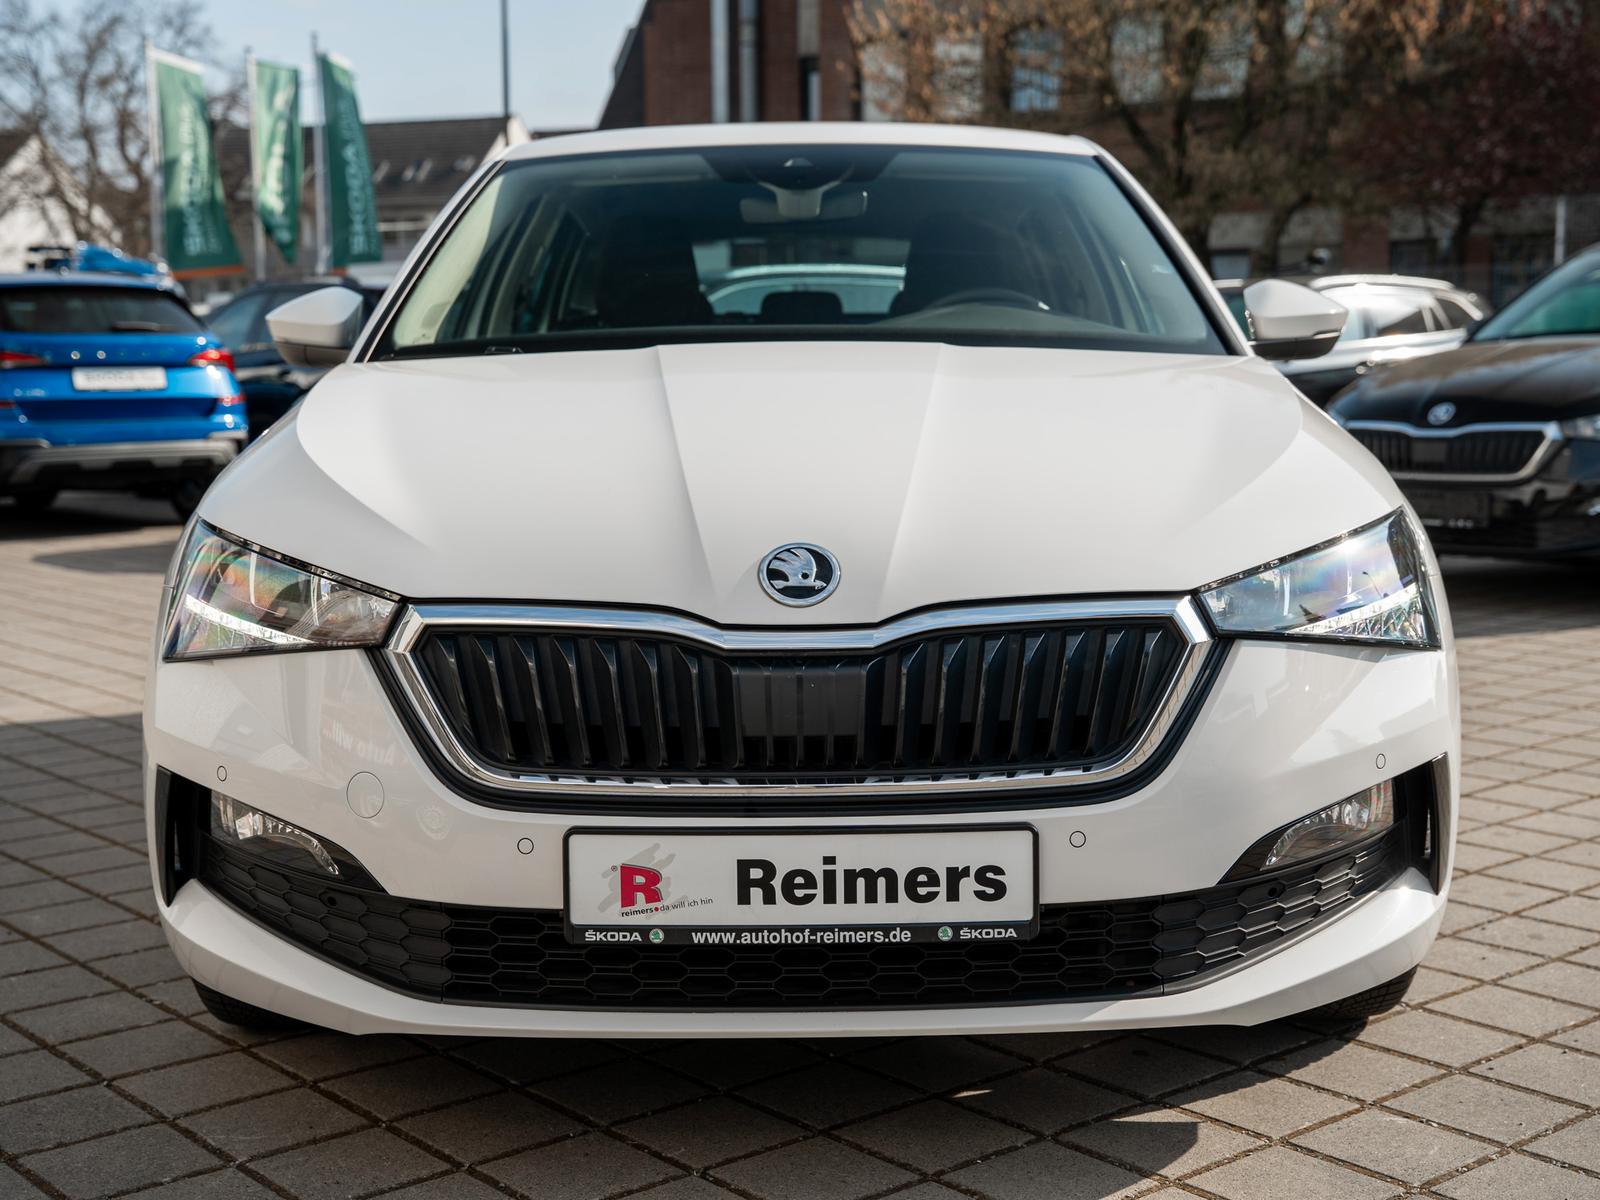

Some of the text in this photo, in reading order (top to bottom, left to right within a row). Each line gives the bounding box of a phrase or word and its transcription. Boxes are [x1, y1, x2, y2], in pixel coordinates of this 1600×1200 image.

[620, 863, 663, 908] R
[736, 856, 1008, 906] Reimers
[621, 897, 714, 918] reimers da will ich hin
[584, 927, 1018, 944] ŠKODA www.autohof-reimers.de ŠKODA
